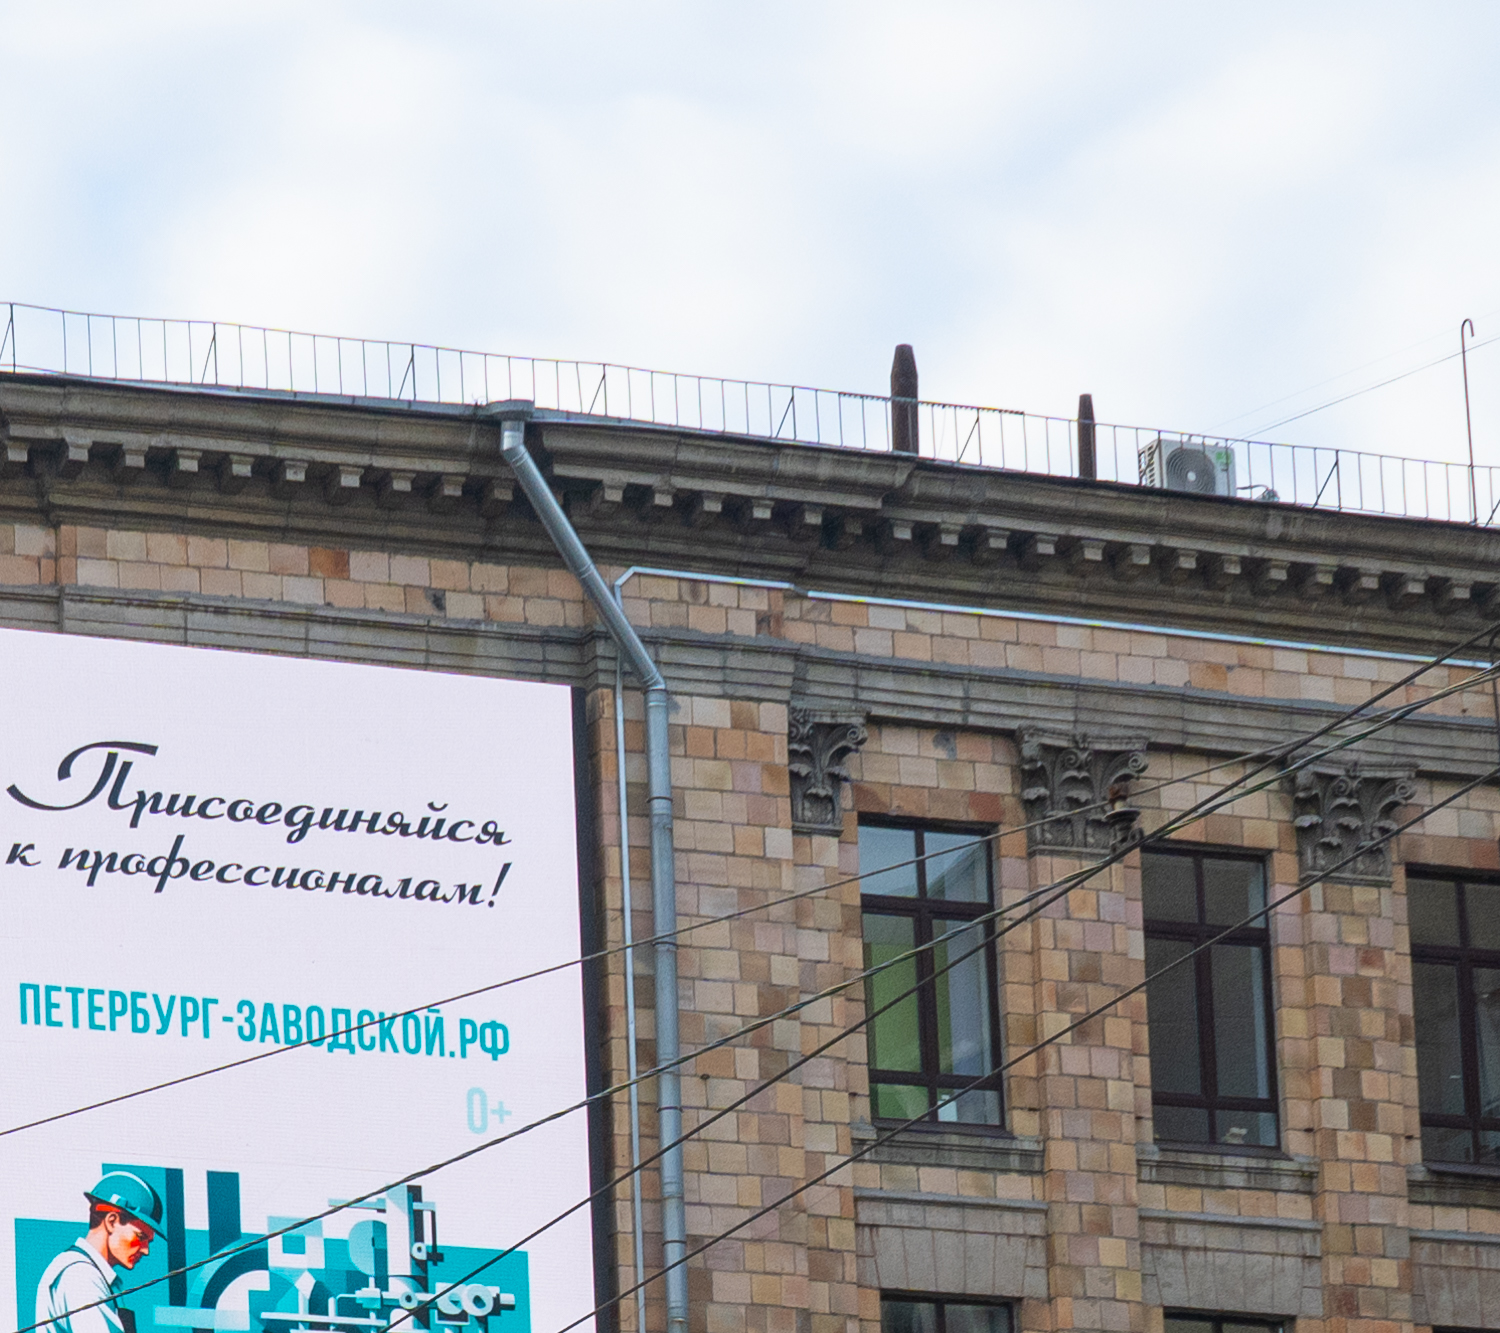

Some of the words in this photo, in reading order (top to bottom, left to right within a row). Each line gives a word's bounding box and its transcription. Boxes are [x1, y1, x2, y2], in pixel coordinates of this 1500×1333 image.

[6, 741, 512, 846] Присоединяйся
[5, 839, 41, 867] к
[58, 834, 511, 908] профессионалам!
[18, 983, 511, 1062] ПЕТЕРБУРГ-ЗАВОДСКОЙ.РФ
[466, 1087, 512, 1134] 0+
